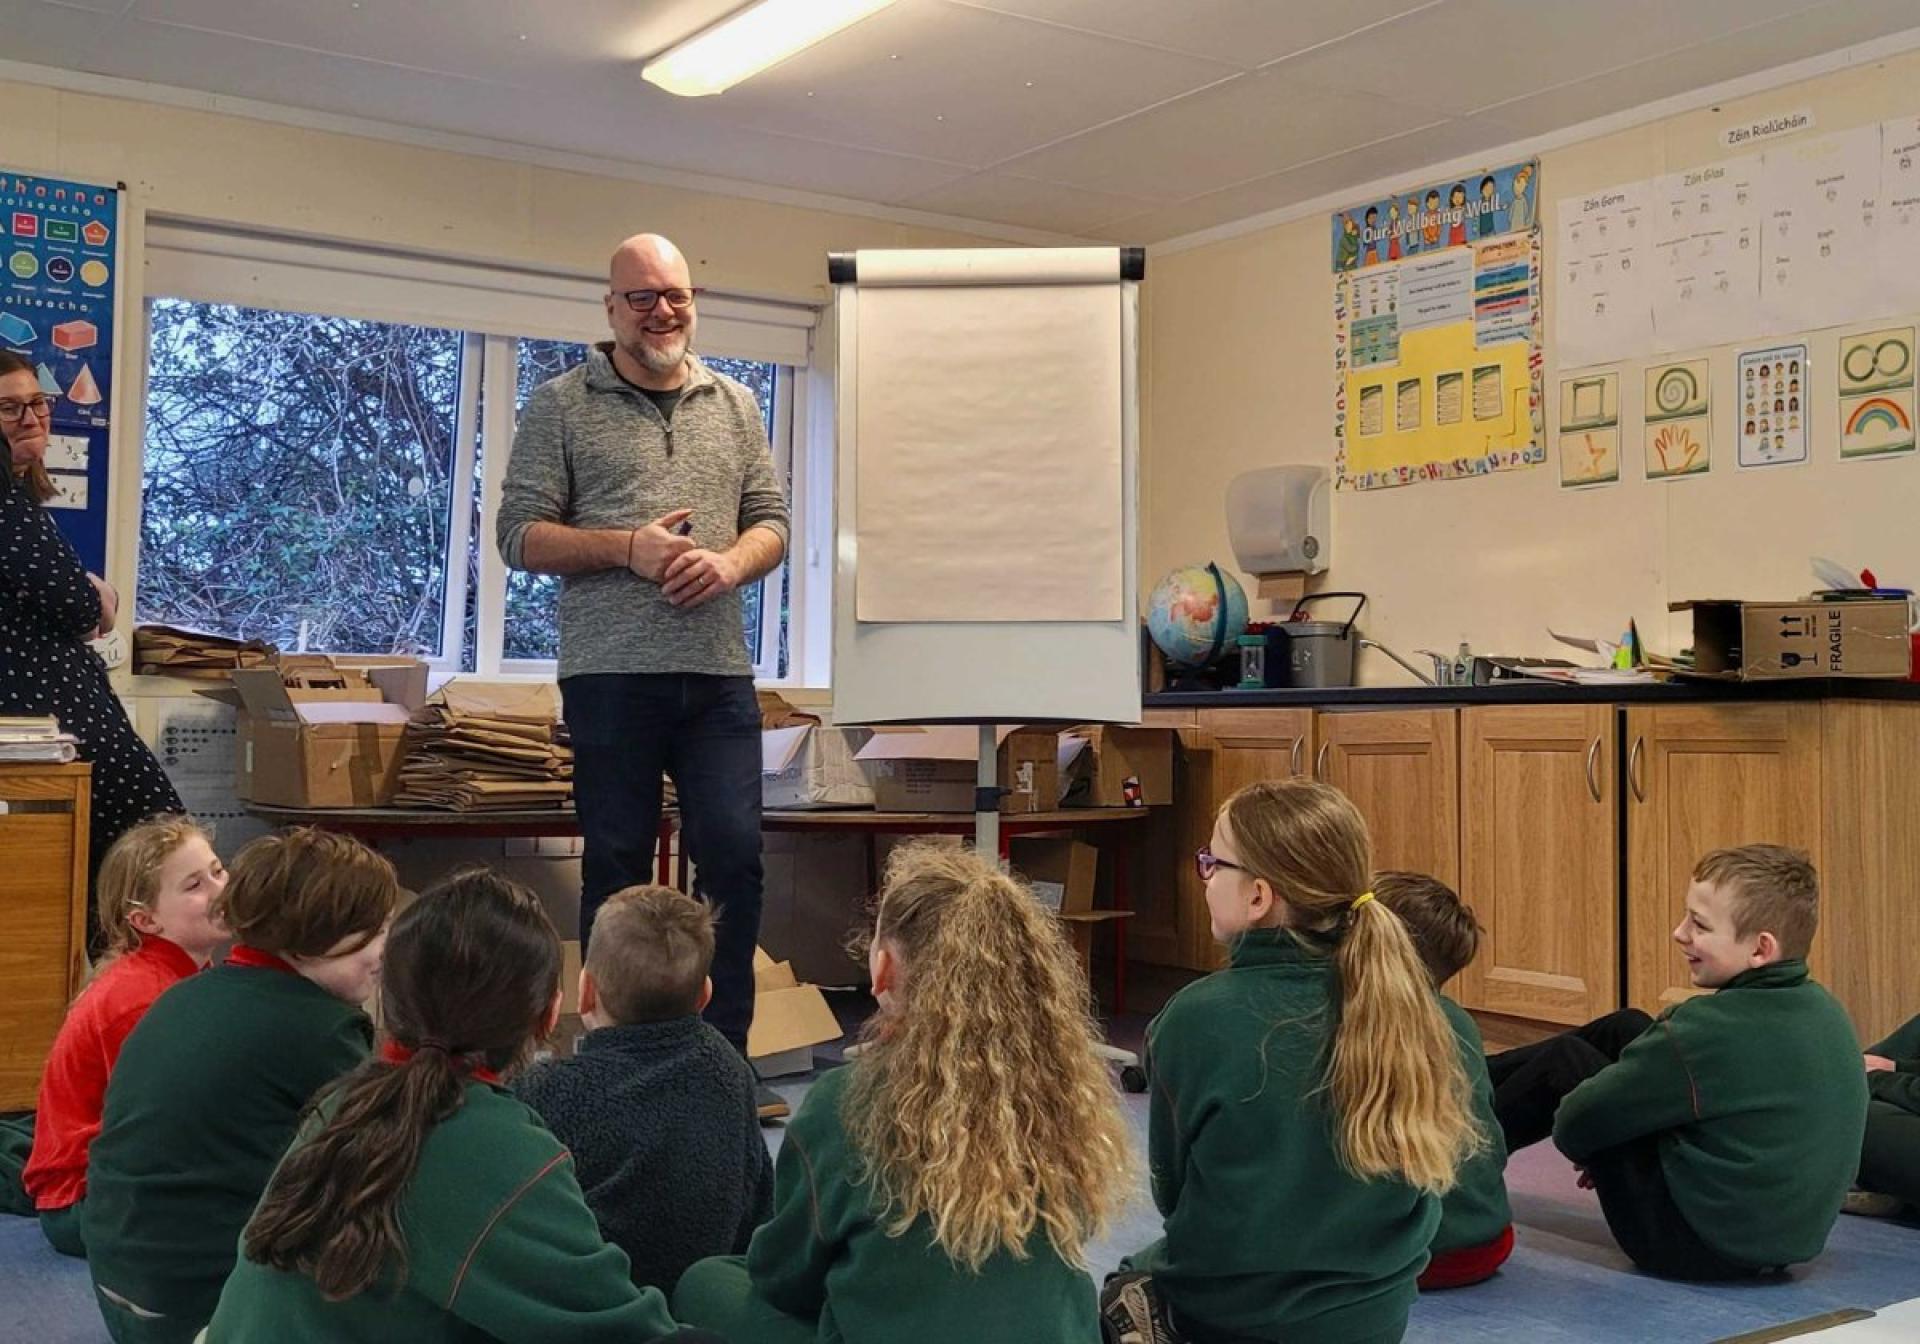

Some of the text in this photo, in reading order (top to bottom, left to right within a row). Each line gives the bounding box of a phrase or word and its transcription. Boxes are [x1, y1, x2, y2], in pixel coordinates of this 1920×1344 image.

[1363, 226, 1387, 243] Our
[1393, 206, 1464, 236] Wellbeing
[1829, 610, 1842, 672] FRAGILE
